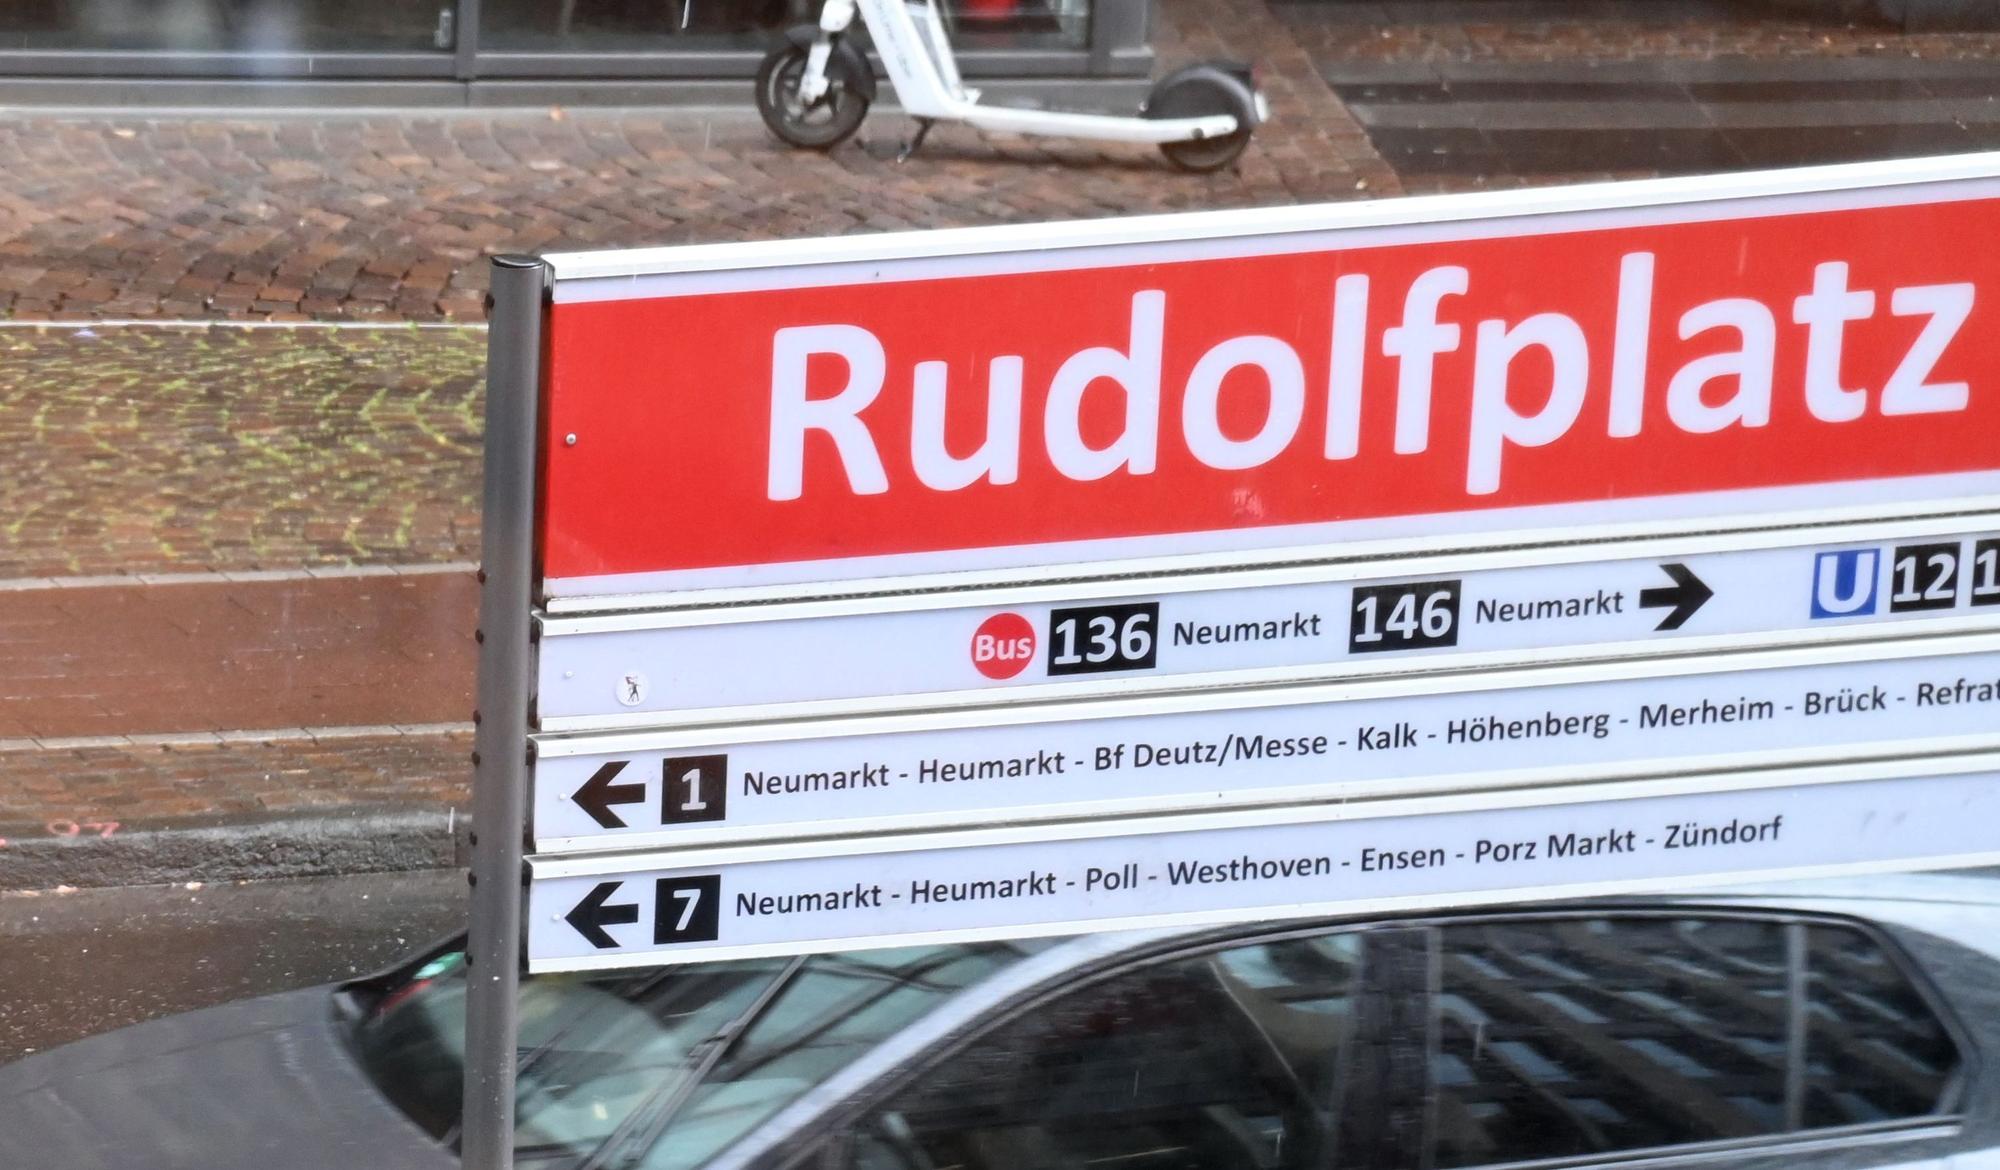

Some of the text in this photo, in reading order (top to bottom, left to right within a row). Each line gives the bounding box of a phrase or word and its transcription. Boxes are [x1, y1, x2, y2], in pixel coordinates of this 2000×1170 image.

[766, 251, 1976, 501] Rudolfplatz
[975, 634, 1032, 662] Bus
[1054, 613, 1151, 665] 136
[1173, 611, 1321, 647] Neumarkt
[1355, 590, 1452, 643] 146
[1476, 589, 1624, 624] Neumarkt
[1818, 555, 1875, 613] U
[1894, 553, 1956, 602] 12
[681, 768, 707, 811] 1
[743, 762, 890, 797] Neumarkt
[919, 749, 1065, 784] Heumarkt
[1094, 743, 1125, 771] Bf
[1134, 733, 1328, 768] Deutz/Messe
[1357, 722, 1418, 751] Kalk
[1447, 711, 1610, 744] Höhenberg
[1639, 698, 1774, 729] Merheim
[1804, 685, 1887, 716] Brück
[673, 888, 701, 931] 7
[736, 882, 882, 917] Neumarkt
[911, 870, 1057, 905] Heumarkt
[1086, 863, 1138, 892] Poll
[1167, 855, 1331, 886] Westhoven
[1361, 847, 1445, 872] Ensen
[1475, 839, 1537, 864] Porz
[1547, 828, 1636, 859] Markt
[1664, 815, 1783, 849] Zündorf
